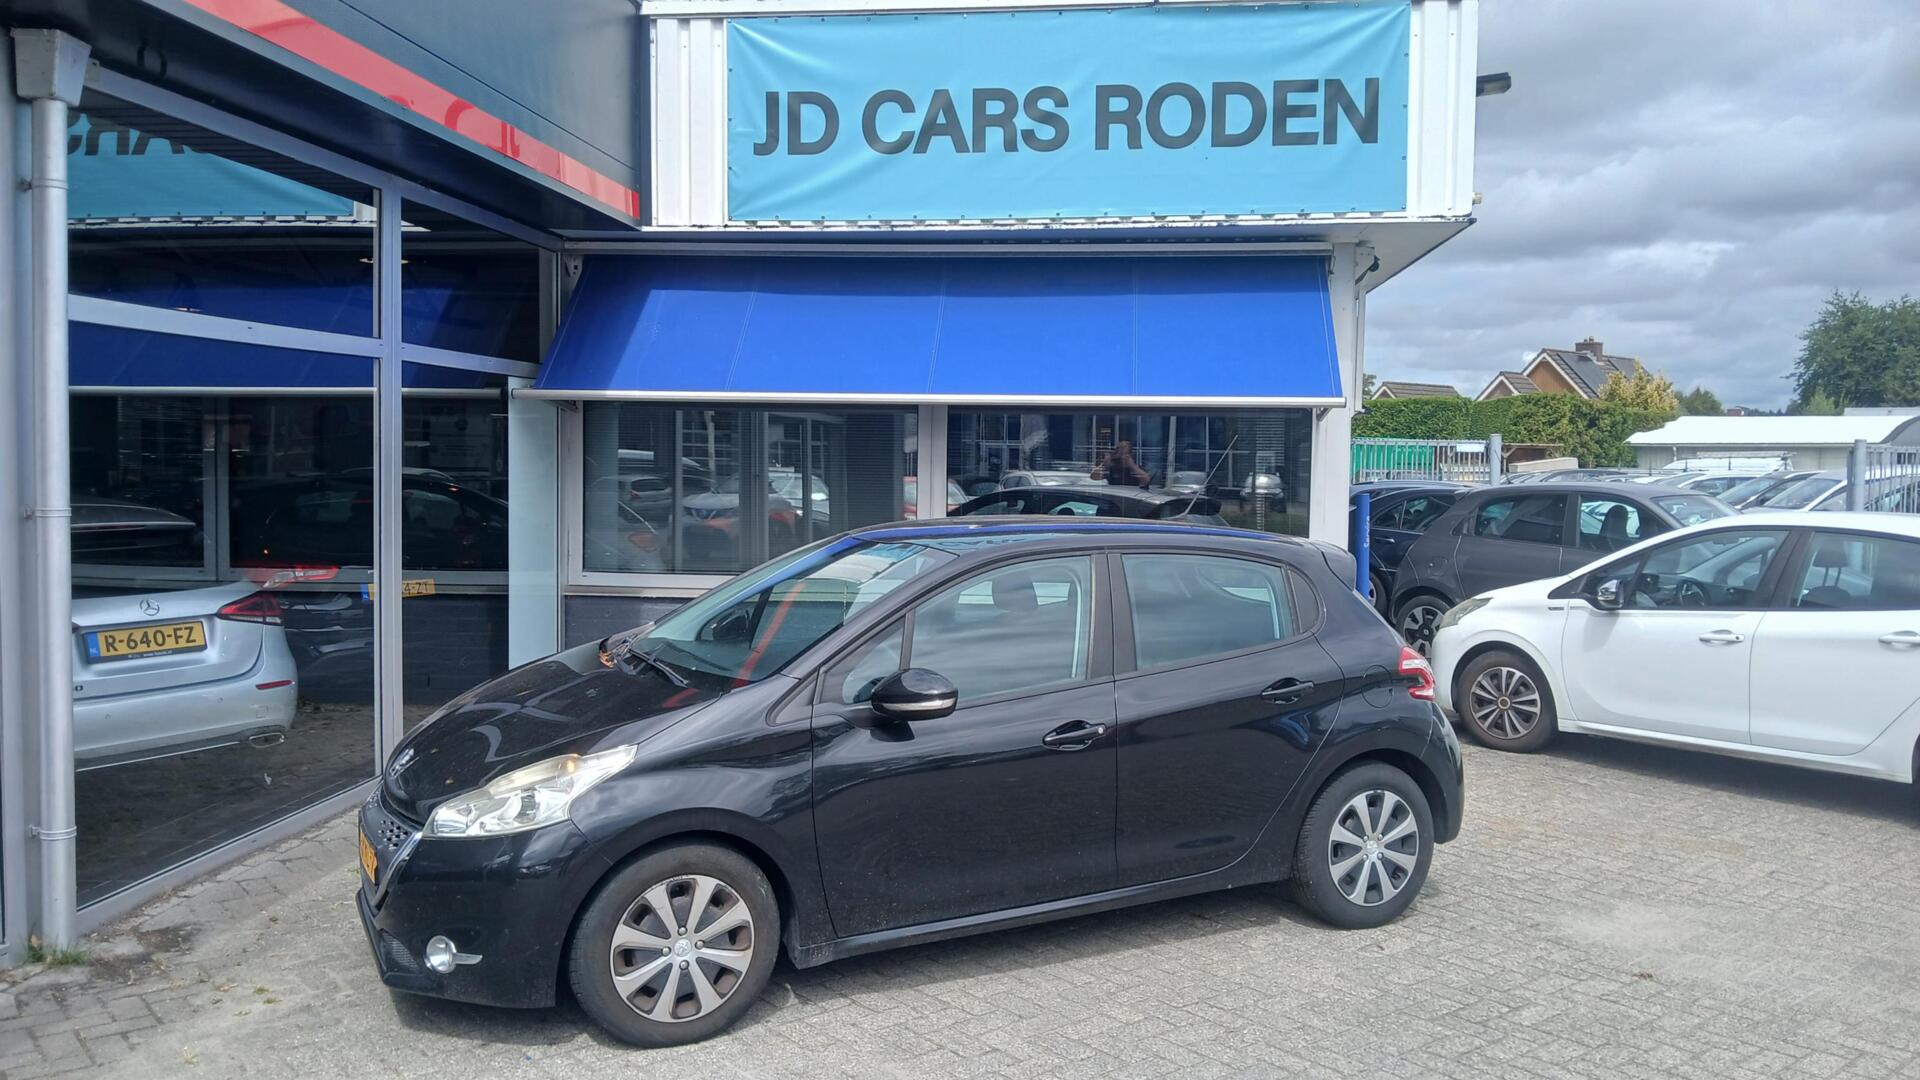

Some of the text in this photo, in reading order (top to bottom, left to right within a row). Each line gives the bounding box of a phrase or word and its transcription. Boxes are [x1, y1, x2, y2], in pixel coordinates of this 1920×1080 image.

[752, 77, 1380, 156] JD CARS RODEN
[104, 626, 196, 652] R-640-FZ
